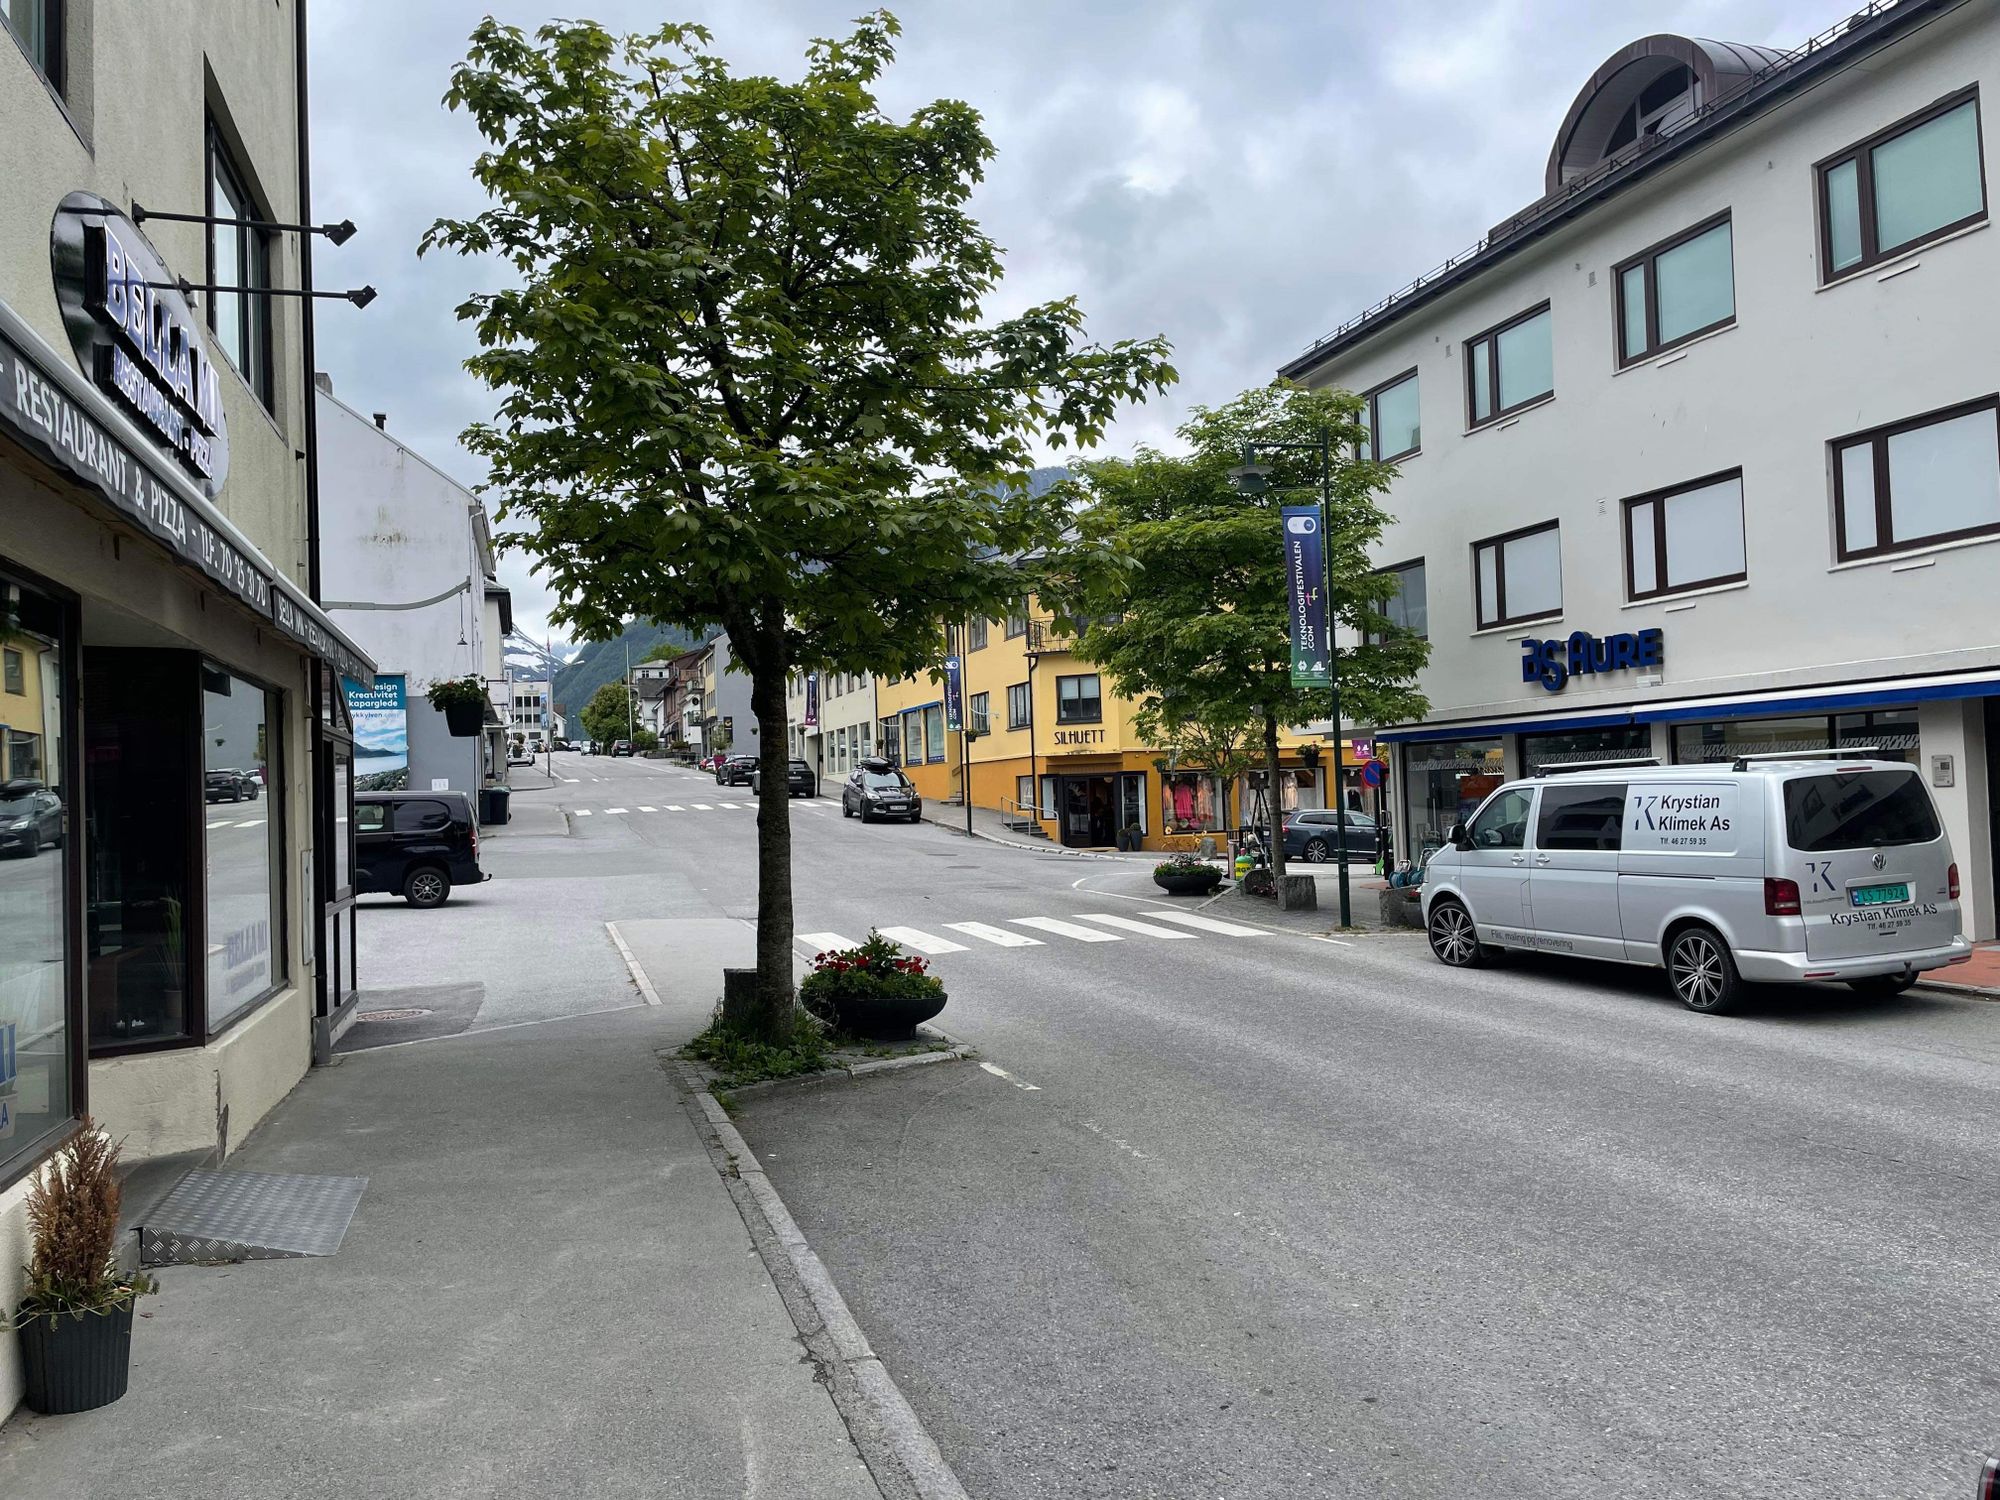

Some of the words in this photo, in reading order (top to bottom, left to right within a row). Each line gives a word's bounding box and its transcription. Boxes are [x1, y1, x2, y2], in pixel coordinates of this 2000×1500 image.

[103, 221, 195, 410] BELLA
[195, 344, 221, 440] MI
[113, 342, 184, 451] RESTAURANT
[14, 357, 127, 496] RESTAURANT
[135, 465, 146, 511] &
[150, 479, 187, 545] PIZZA
[220, 541, 233, 579] 70
[234, 554, 245, 590] 25
[256, 573, 266, 607] 70
[1293, 541, 1308, 651] TEKNOLOGIFESTIVALEN
[1307, 625, 1315, 651] .COM
[348, 691, 398, 699] Kreativitet
[372, 682, 398, 692] esign
[348, 699, 398, 709] kaparglede
[1054, 729, 1105, 745] SILHUETT
[1661, 794, 1720, 813] Krystian
[1659, 816, 1707, 831] Klimek
[1710, 815, 1730, 831] As
[1698, 838, 1707, 846] 35
[1877, 887, 1905, 900] 77924
[1830, 909, 1882, 926] Krystian
[1883, 904, 1921, 919] Klimek
[1923, 903, 1938, 915] AS
